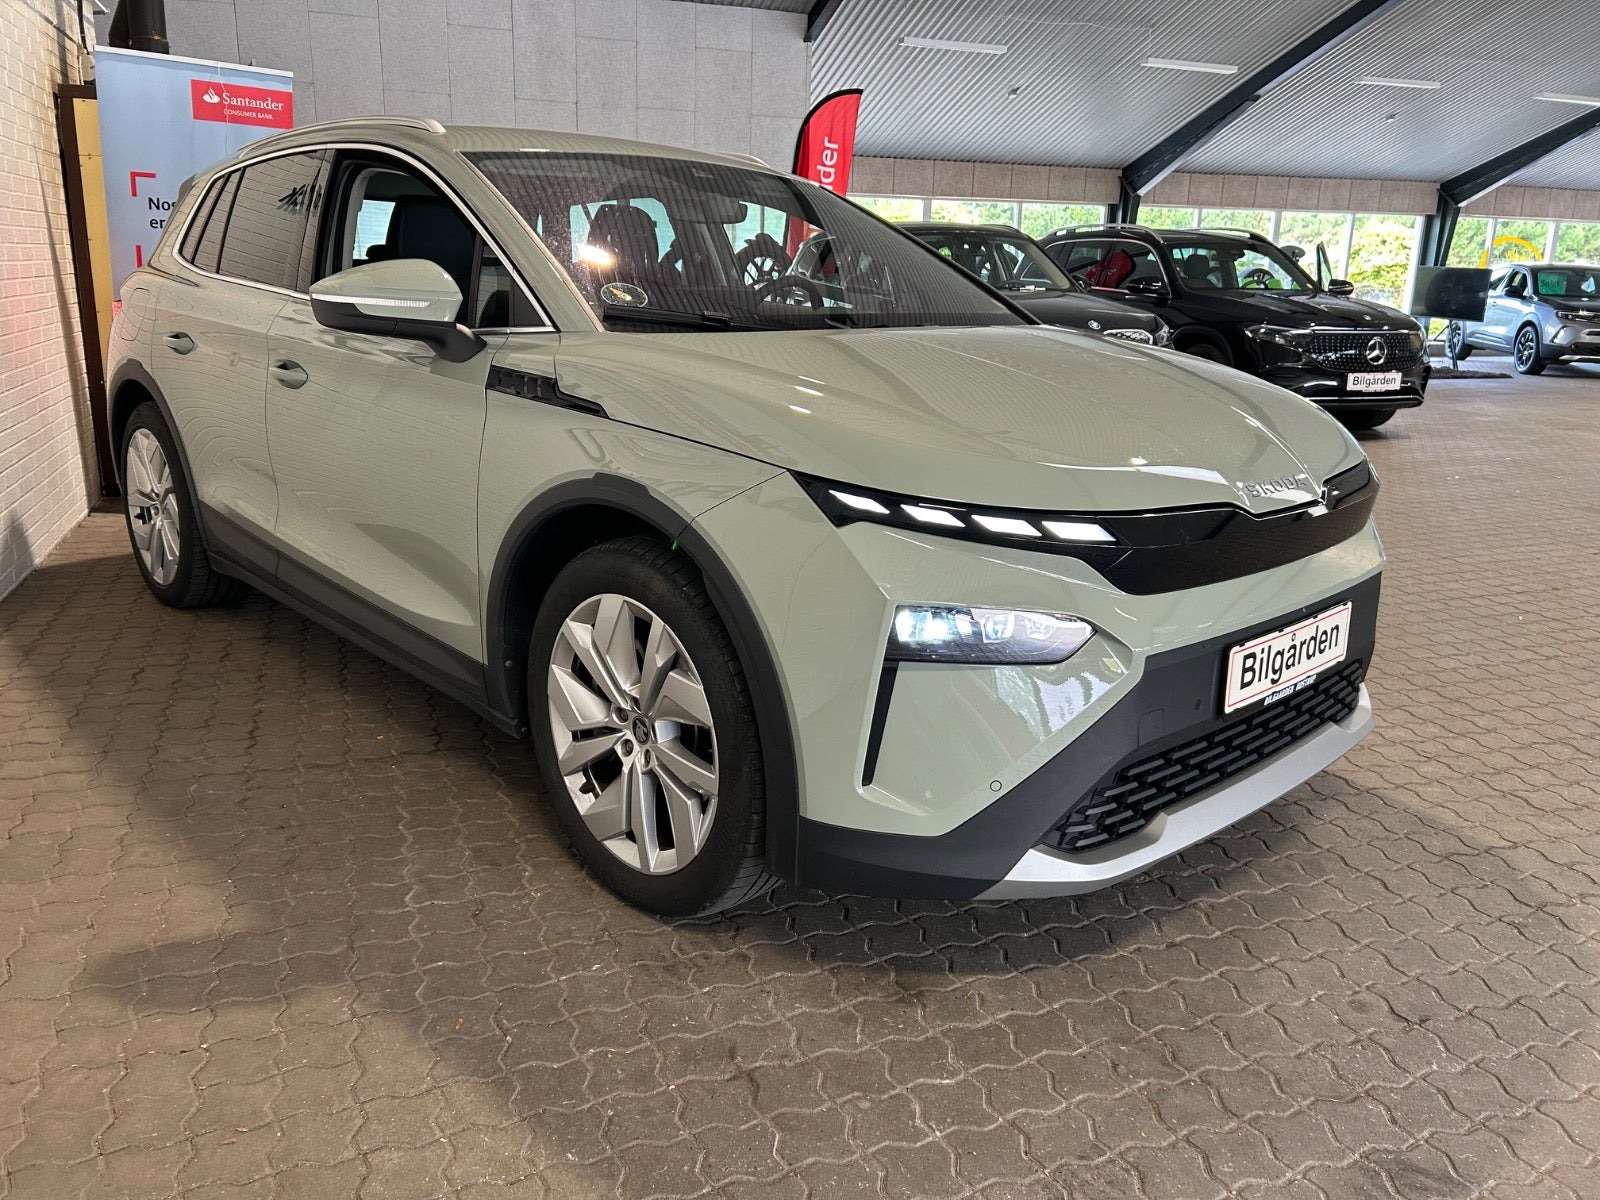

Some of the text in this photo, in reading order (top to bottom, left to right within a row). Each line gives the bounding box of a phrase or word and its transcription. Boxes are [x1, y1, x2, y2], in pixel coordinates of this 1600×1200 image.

[222, 92, 284, 111] Santander
[223, 108, 273, 120] CONSUMER BANK
[150, 218, 165, 229] er
[1352, 375, 1396, 388] Bilgården
[1239, 623, 1340, 690] Bilgården
